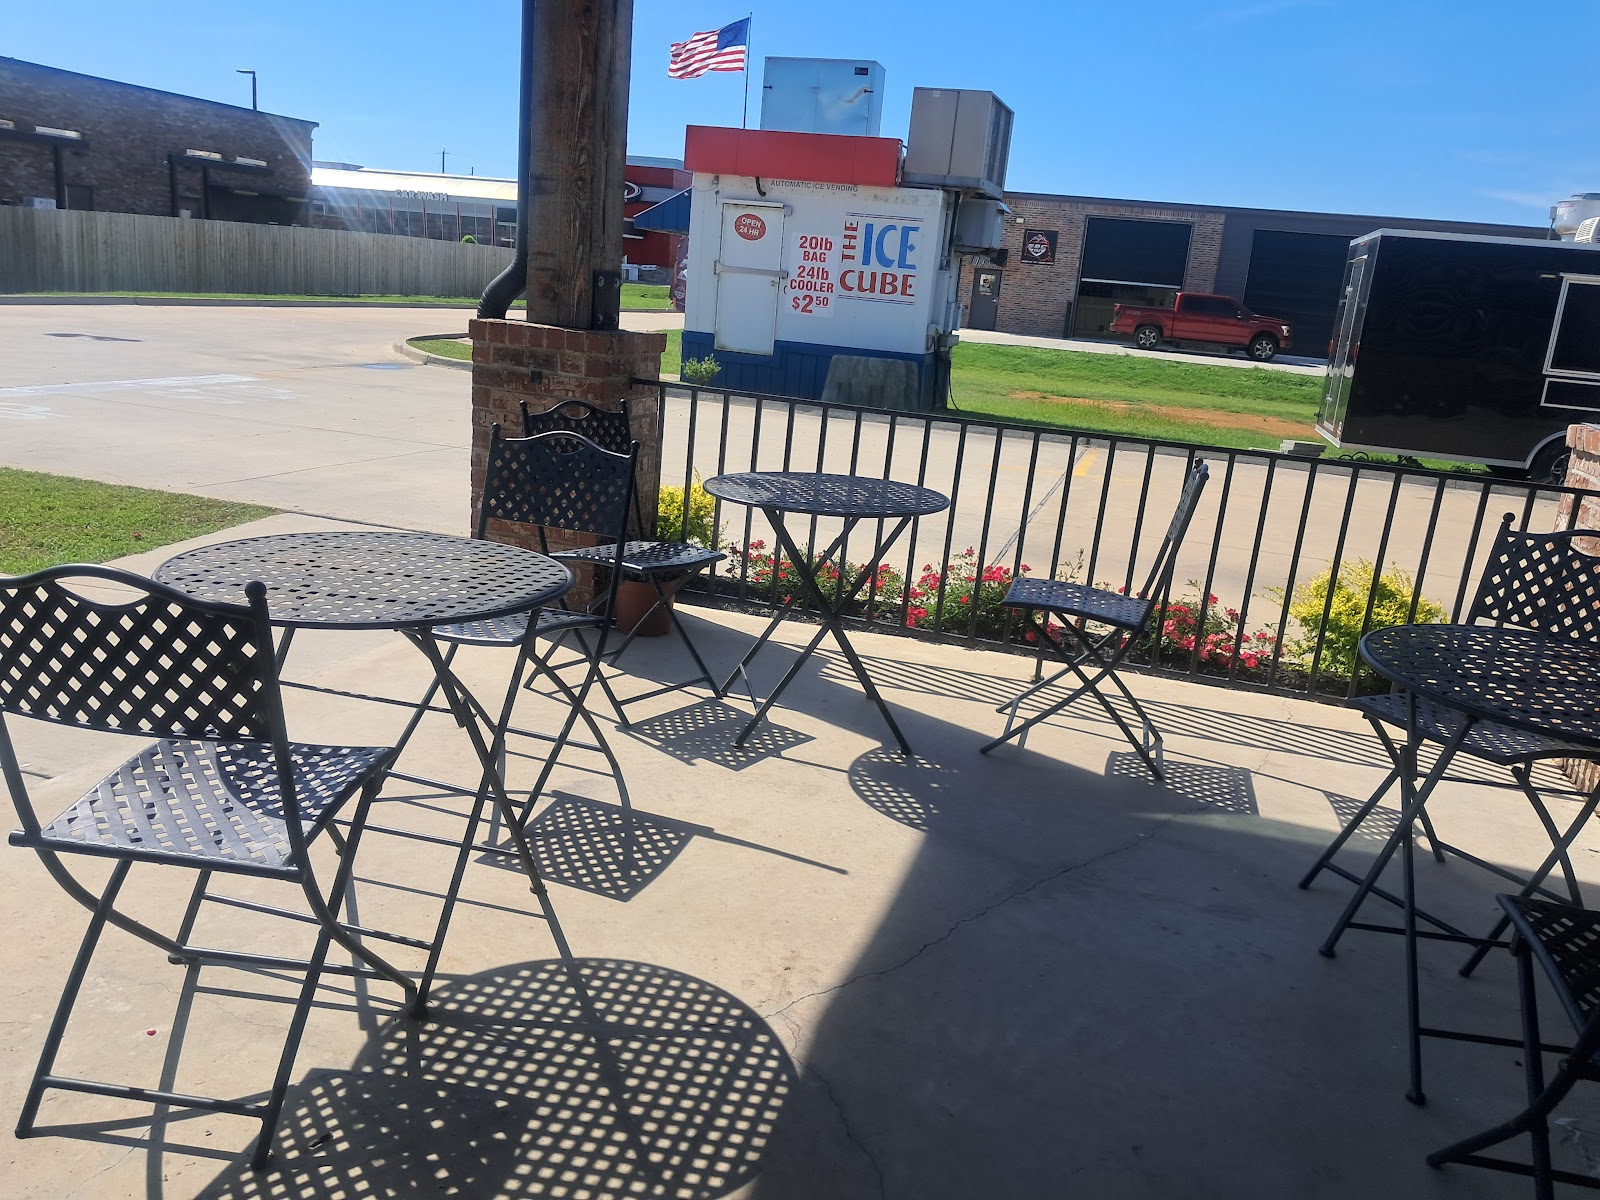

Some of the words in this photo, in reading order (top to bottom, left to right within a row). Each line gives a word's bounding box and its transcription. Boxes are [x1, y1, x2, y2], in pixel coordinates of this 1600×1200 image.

[770, 180, 811, 189] AUTOMATIC
[827, 183, 859, 192] VENDING
[395, 189, 416, 199] CAR
[417, 190, 448, 202] WASH
[741, 217, 762, 228] OPEN
[740, 225, 748, 234] 24
[749, 227, 760, 237] HR
[799, 235, 833, 252] 20lb
[841, 220, 859, 263] THE
[862, 223, 920, 270] ICE
[803, 250, 827, 263] BAG
[797, 265, 830, 281] 24lb
[789, 278, 834, 294] COOLER
[839, 269, 916, 297] CUBE
